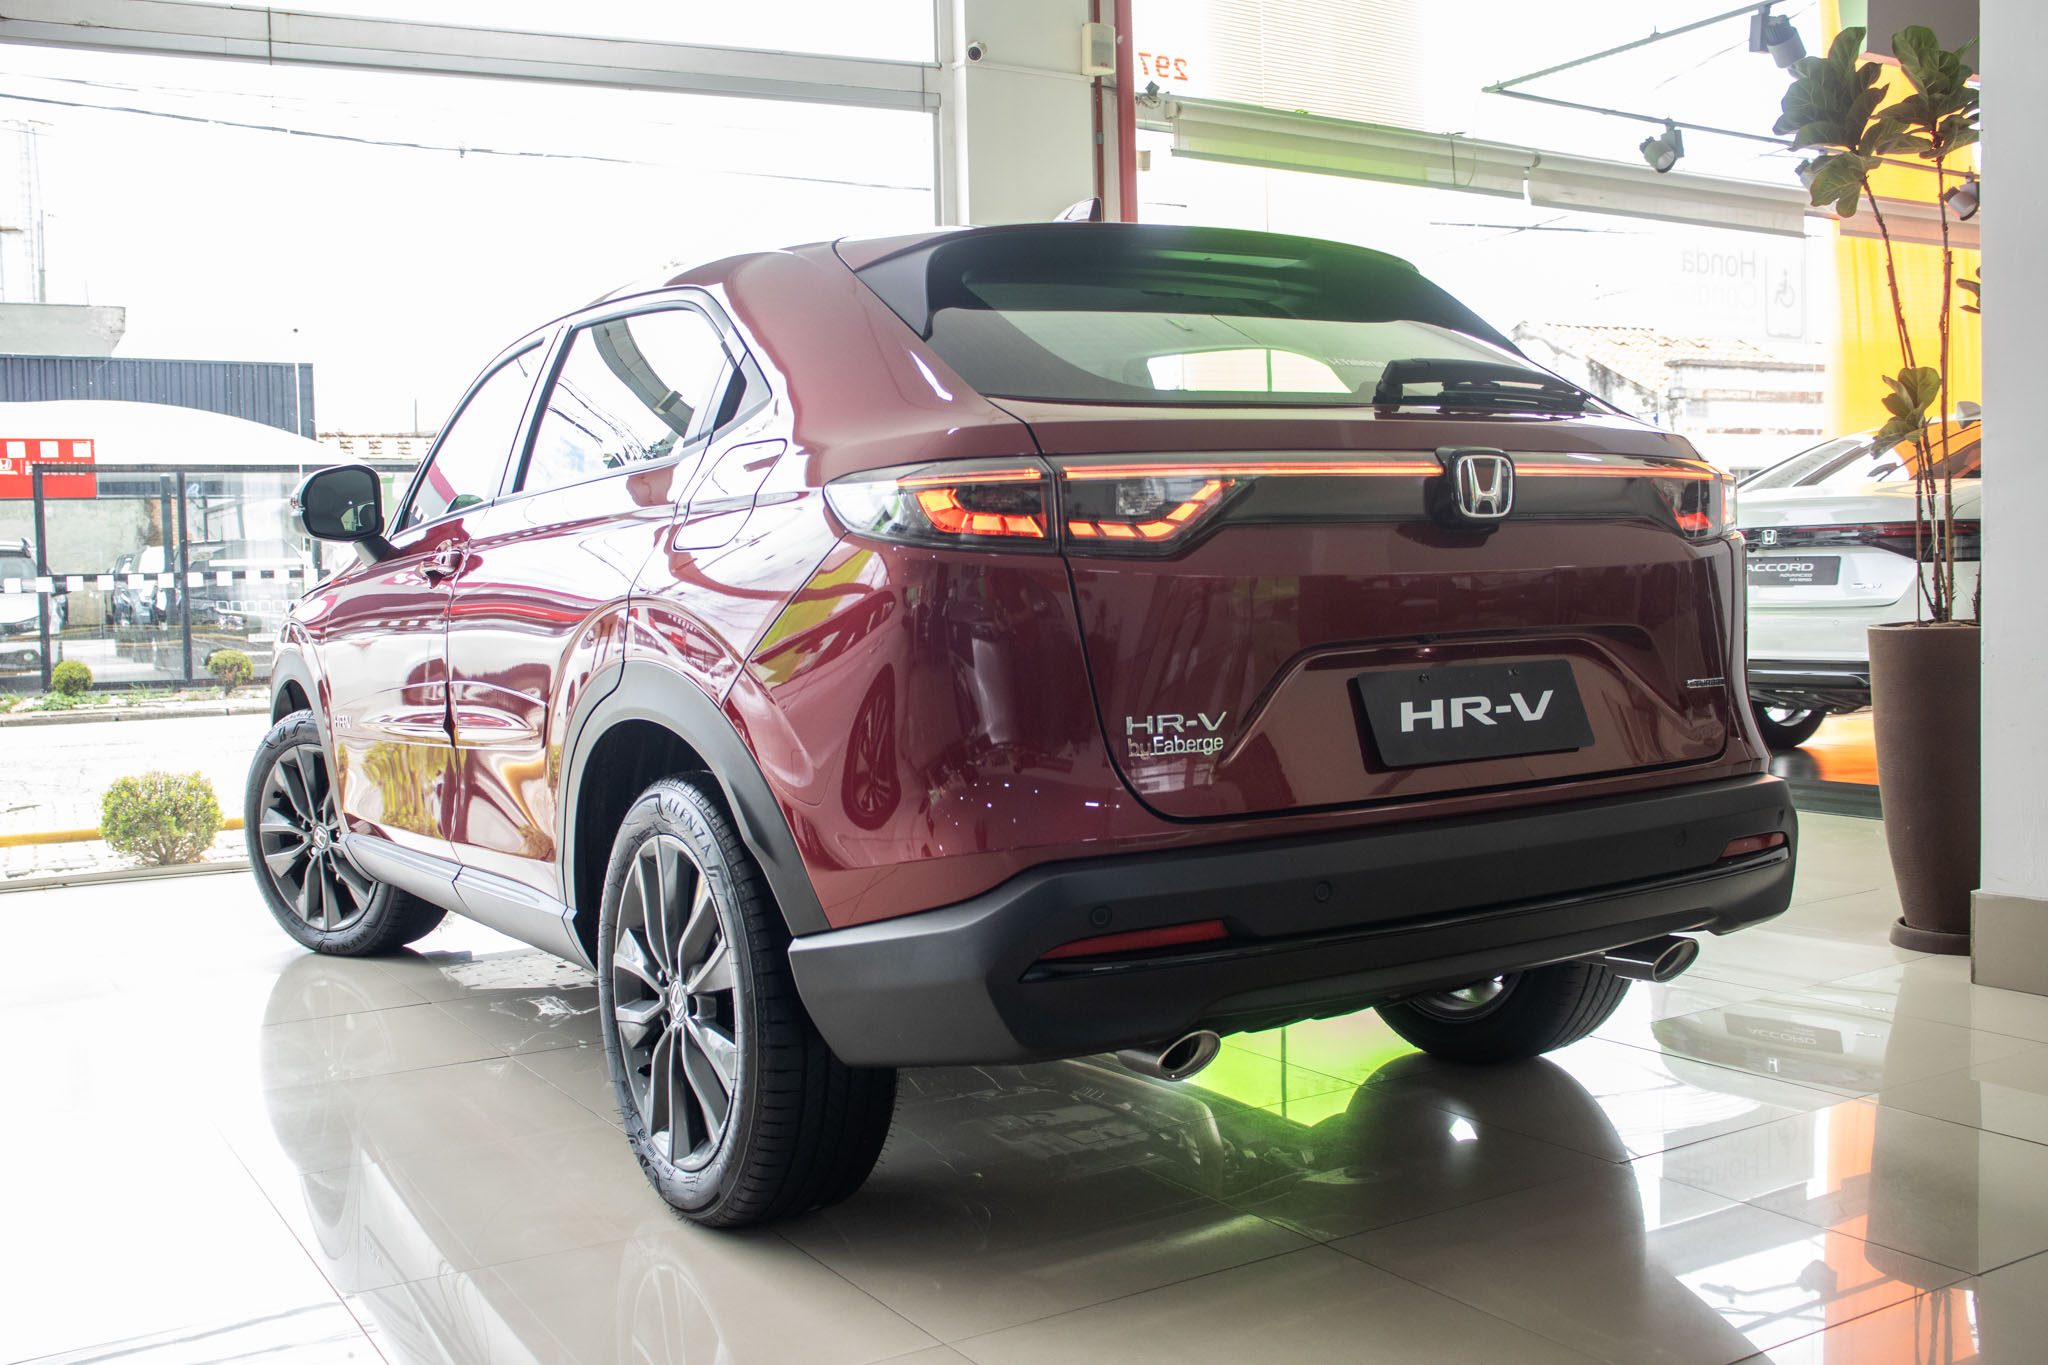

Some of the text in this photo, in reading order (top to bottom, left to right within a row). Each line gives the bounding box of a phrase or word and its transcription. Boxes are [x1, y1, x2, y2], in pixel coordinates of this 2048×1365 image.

[1745, 563, 1814, 572] ACCORD
[1126, 711, 1227, 735] HR-V
[1400, 689, 1554, 733] HR-V
[1127, 735, 1224, 760] by Faberge
[664, 798, 711, 858] ALENZA
